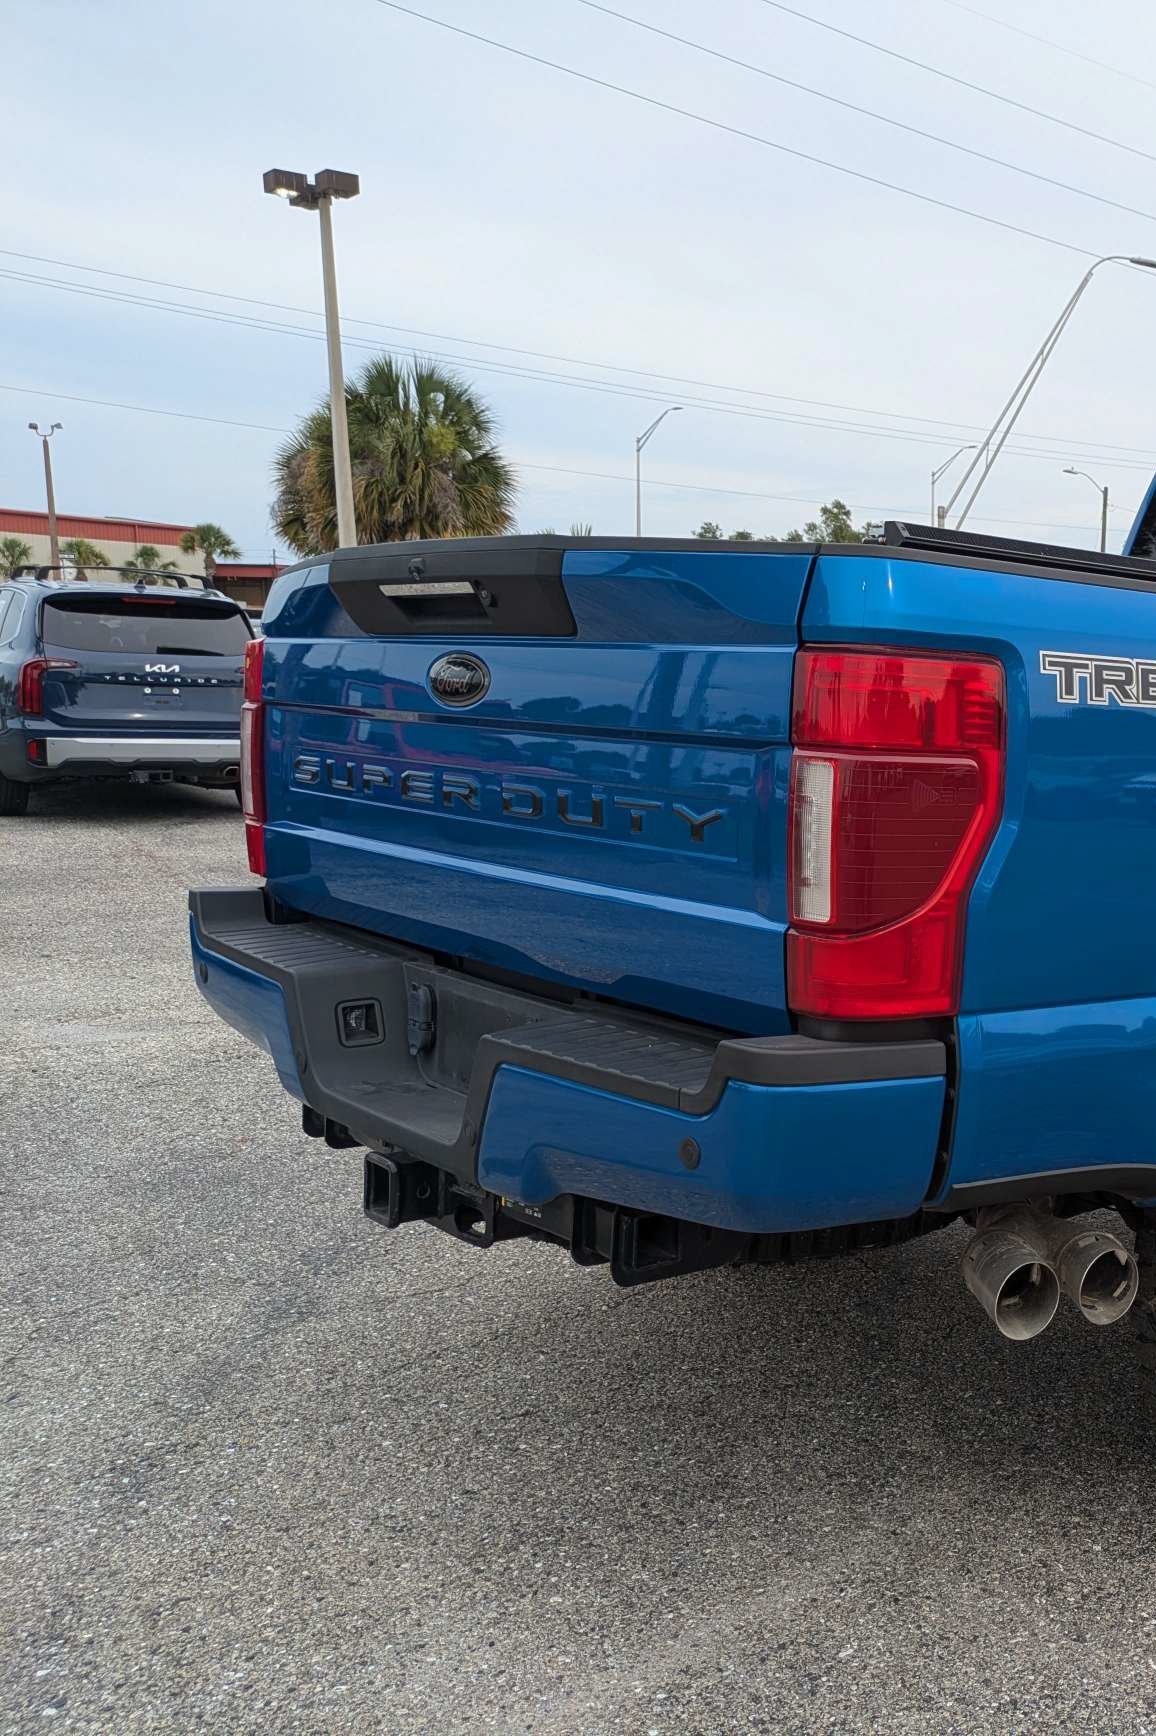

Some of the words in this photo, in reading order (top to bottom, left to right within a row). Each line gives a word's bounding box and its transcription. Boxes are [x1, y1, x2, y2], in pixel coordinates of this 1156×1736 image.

[144, 663, 180, 673] KIA
[104, 674, 218, 684] TELLURIDE
[294, 755, 480, 811] SUPER
[502, 782, 728, 842] DUTY
